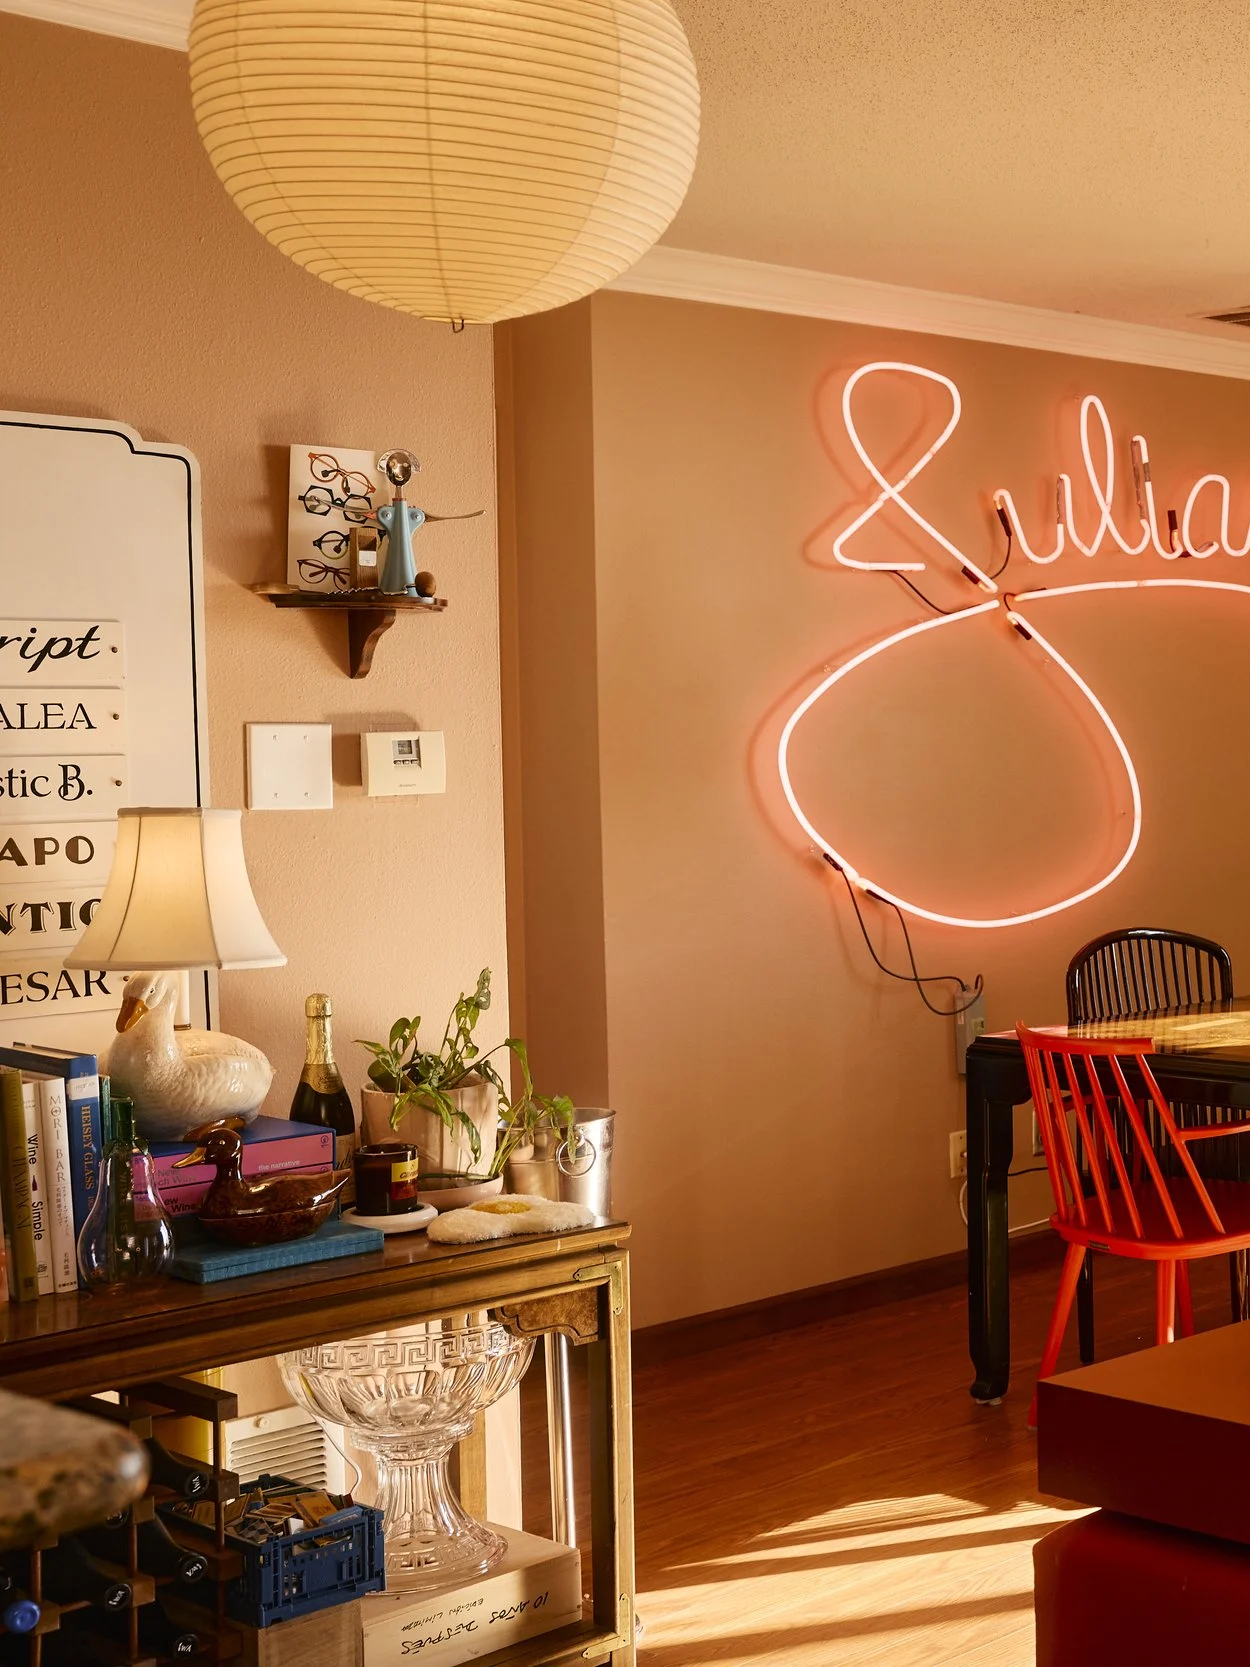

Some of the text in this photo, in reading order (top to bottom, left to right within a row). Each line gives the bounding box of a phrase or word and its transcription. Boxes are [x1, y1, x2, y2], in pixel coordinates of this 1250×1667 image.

[0, 969, 112, 1006] ESAR
[80, 1104, 93, 1151] HEISEY
[55, 1147, 67, 1183] BAR
[83, 1152, 95, 1190] GLASS
[270, 1159, 301, 1170] narrative
[27, 1133, 43, 1241] Wine Simple
[533, 1591, 549, 1609] 10
